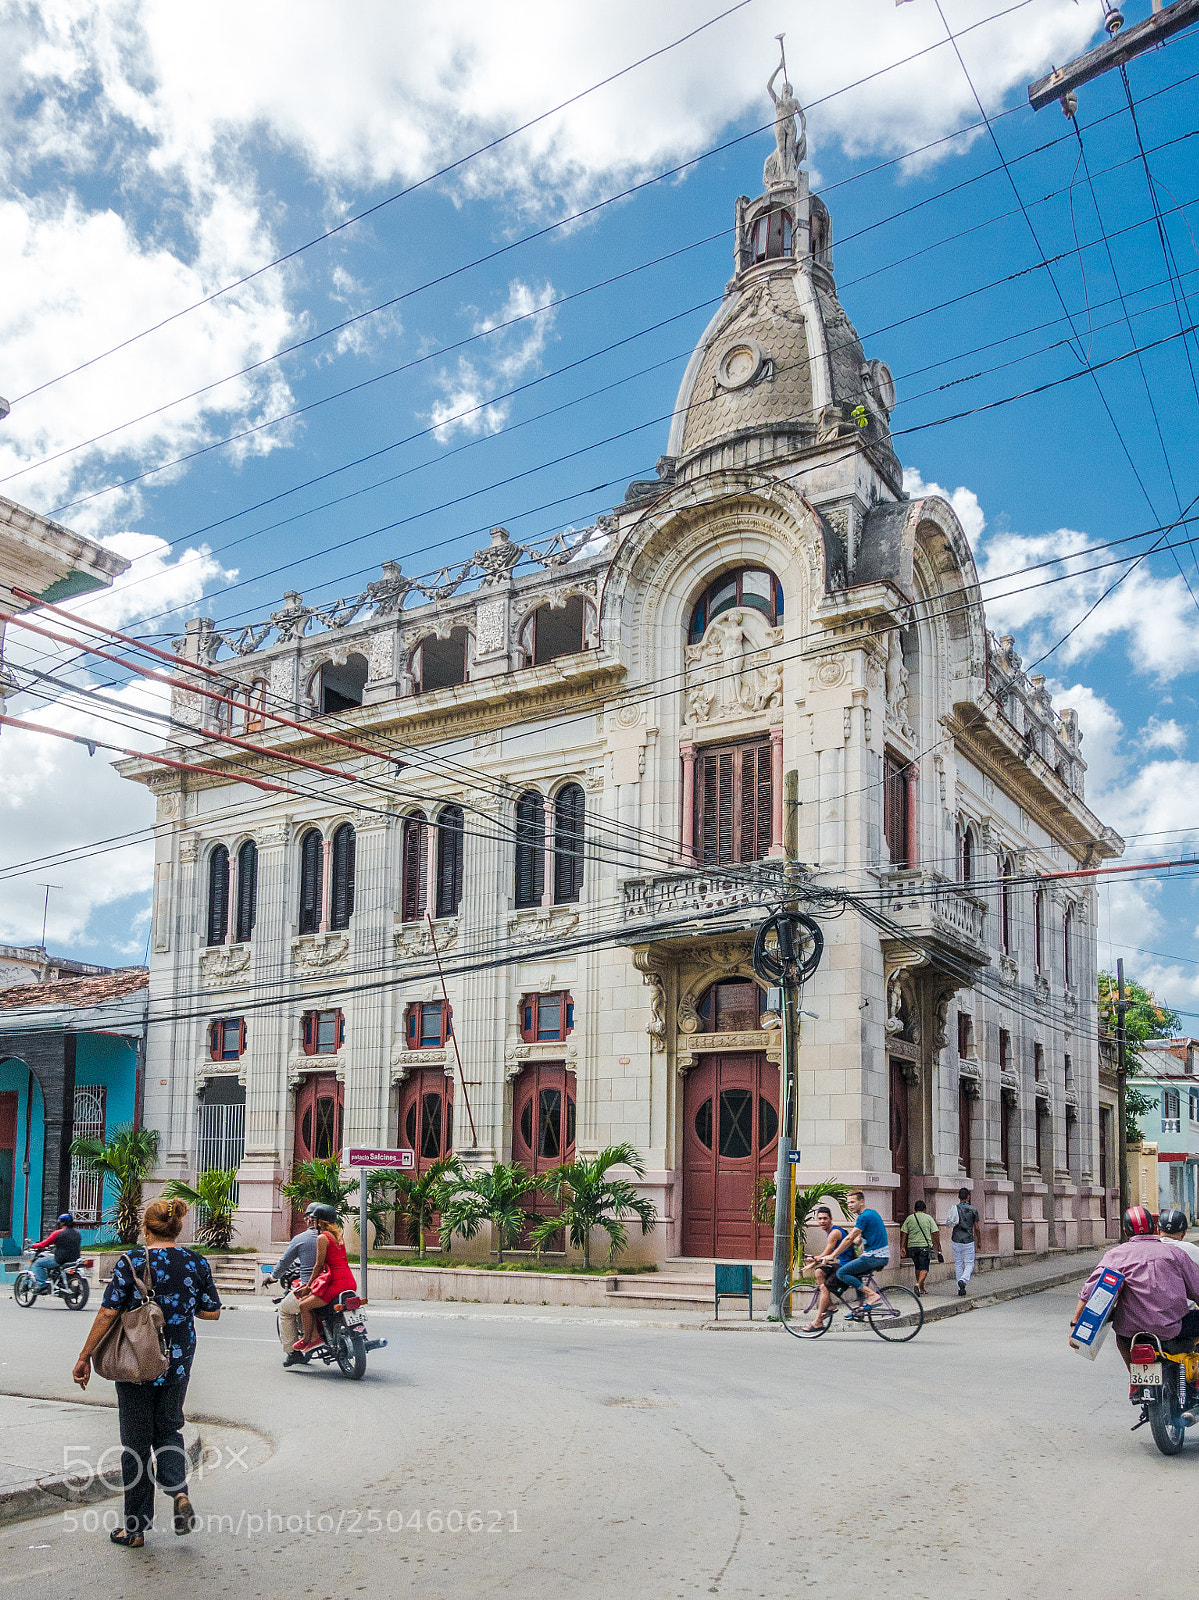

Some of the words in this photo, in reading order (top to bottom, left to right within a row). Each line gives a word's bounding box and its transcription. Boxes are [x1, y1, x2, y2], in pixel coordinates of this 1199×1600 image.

[369, 1153, 397, 1161] Salcines
[1143, 1364, 1149, 1373] P
[1132, 1374, 1160, 1384] 36498
